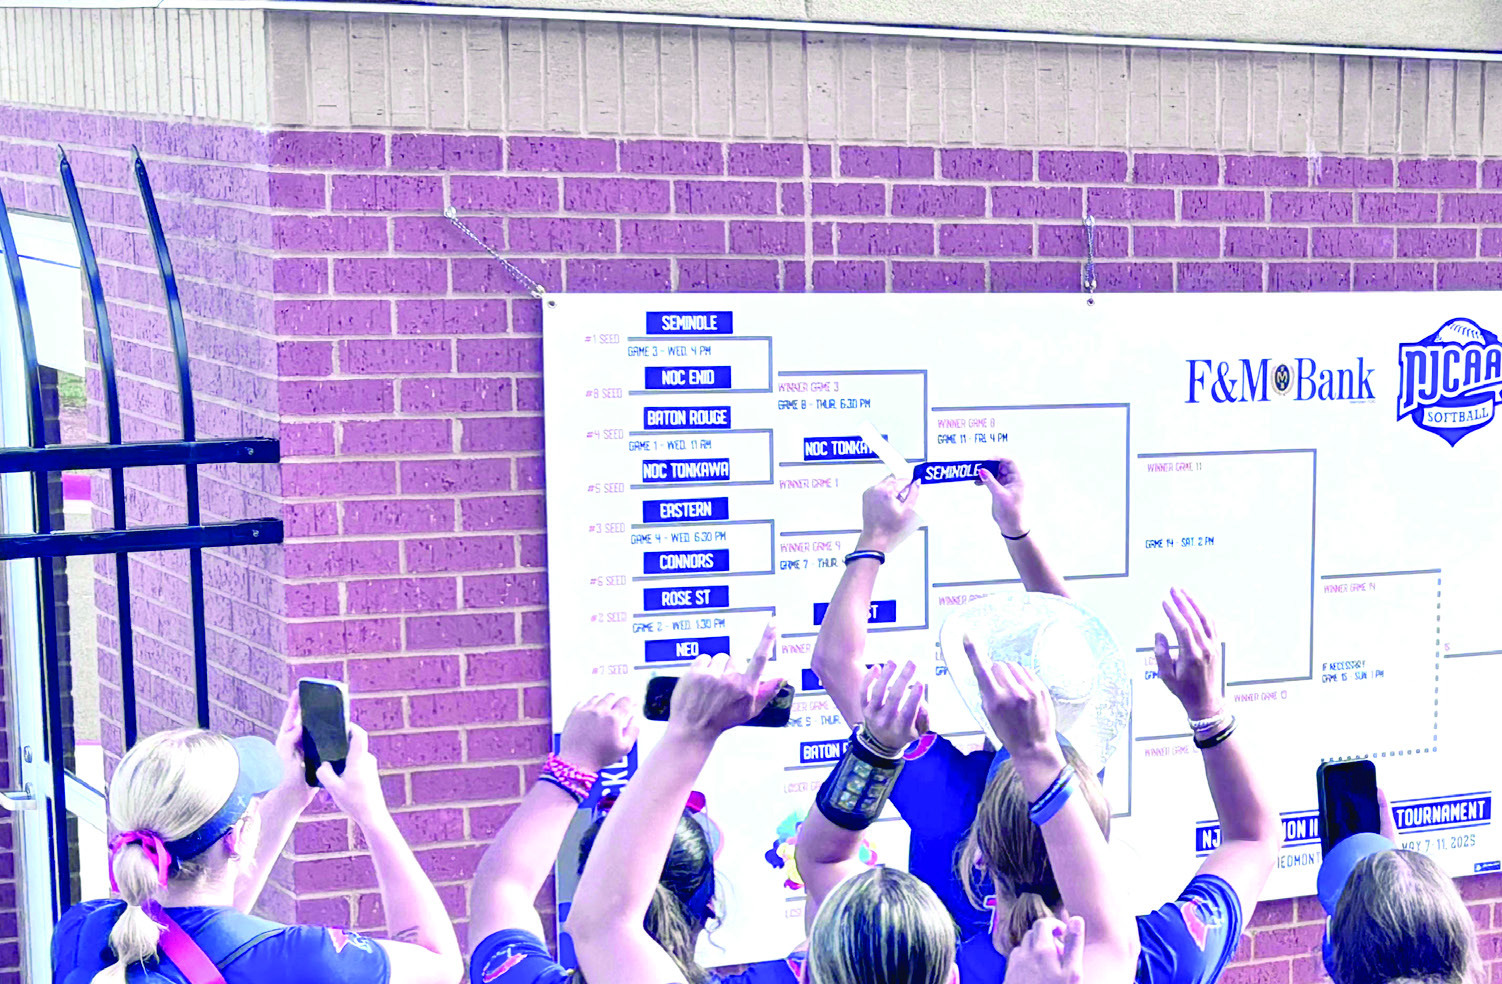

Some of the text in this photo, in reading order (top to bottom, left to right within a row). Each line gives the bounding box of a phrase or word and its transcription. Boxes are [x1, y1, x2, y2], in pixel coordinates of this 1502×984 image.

[662, 315, 717, 331] SEMINOLE
[600, 334, 619, 343] SEED
[628, 346, 649, 356] GAME
[700, 346, 711, 355] PM
[662, 369, 714, 385] NOC ENID
[1185, 358, 1272, 403] F&M
[1293, 357, 1376, 401] Bank
[1404, 349, 1501, 408] NJCAA
[603, 388, 622, 398] SEED
[778, 382, 807, 392] WINNER
[811, 382, 830, 392] GAME
[778, 400, 798, 410] GAME
[860, 399, 870, 408] PM
[647, 409, 727, 426] BATON ROUGE
[1428, 408, 1488, 423] SOFTBALL
[938, 418, 965, 428] WINNER
[969, 418, 987, 428] GAME
[604, 429, 623, 439] SEED
[938, 434, 956, 444] GAME
[998, 433, 1008, 442] PM
[629, 441, 650, 451] GAME
[805, 440, 873, 456] NOC TONKA
[643, 461, 728, 479] NOC TONKAWA
[925, 463, 981, 481] SEMINOLE
[1176, 462, 1193, 471] GAME
[604, 483, 624, 493] SEED
[779, 479, 809, 489] WINNER
[812, 478, 831, 488] GAME
[660, 501, 712, 519] EASTERN
[605, 523, 625, 533] SEED
[631, 534, 651, 544] GAME
[715, 532, 726, 541] PM
[1145, 539, 1163, 548] GAME
[1205, 537, 1214, 545] PM
[781, 542, 809, 552] WINNER
[813, 542, 832, 551] GAME
[660, 553, 714, 570] CONNORS
[780, 560, 800, 570] GAME
[606, 575, 626, 585] SEED
[661, 589, 711, 606] ROSE ST
[633, 622, 653, 633] GAME
[714, 618, 725, 628] PM
[676, 642, 699, 657] NEO
[804, 743, 839, 759] BATON
[1397, 801, 1485, 828] TOURNAMENT
[1451, 834, 1476, 849] 2025
[1277, 853, 1321, 869] IEDMONT
